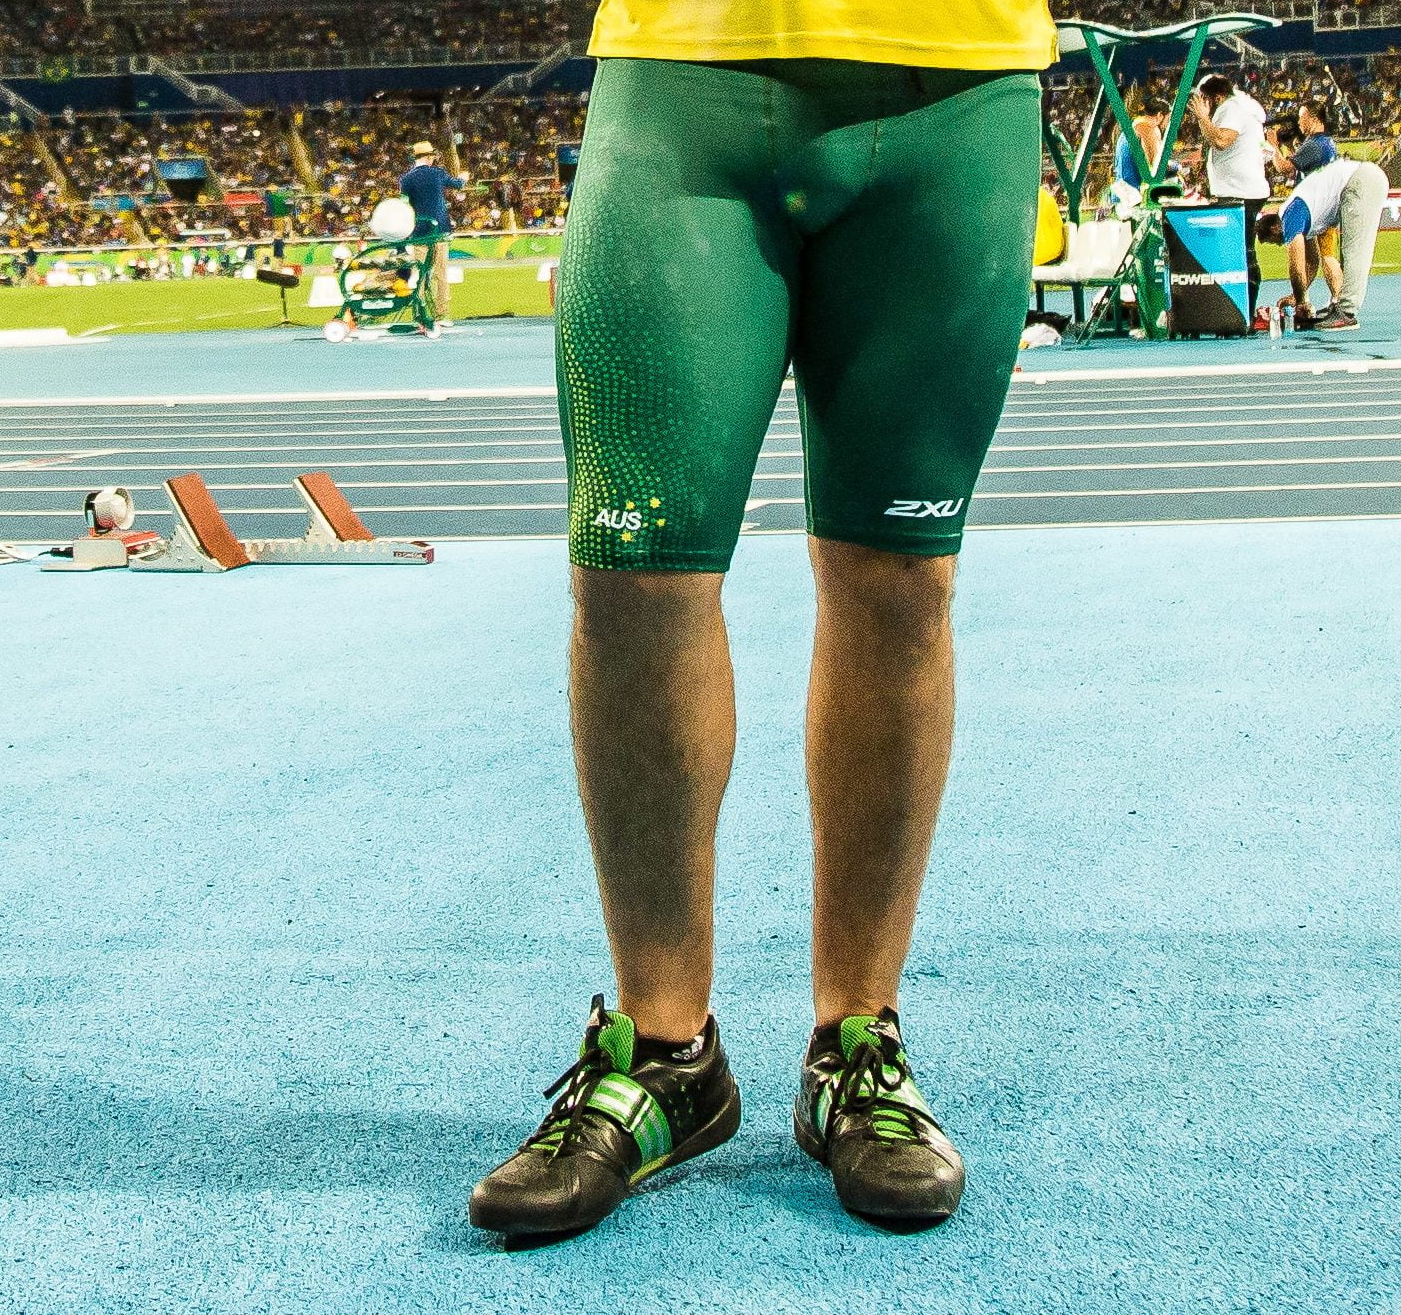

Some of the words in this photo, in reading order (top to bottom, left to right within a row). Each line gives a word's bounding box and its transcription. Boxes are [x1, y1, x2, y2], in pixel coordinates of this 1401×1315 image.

[1170, 270, 1248, 286] POWER
[883, 497, 965, 518] 2XU
[593, 508, 643, 531] AUS
